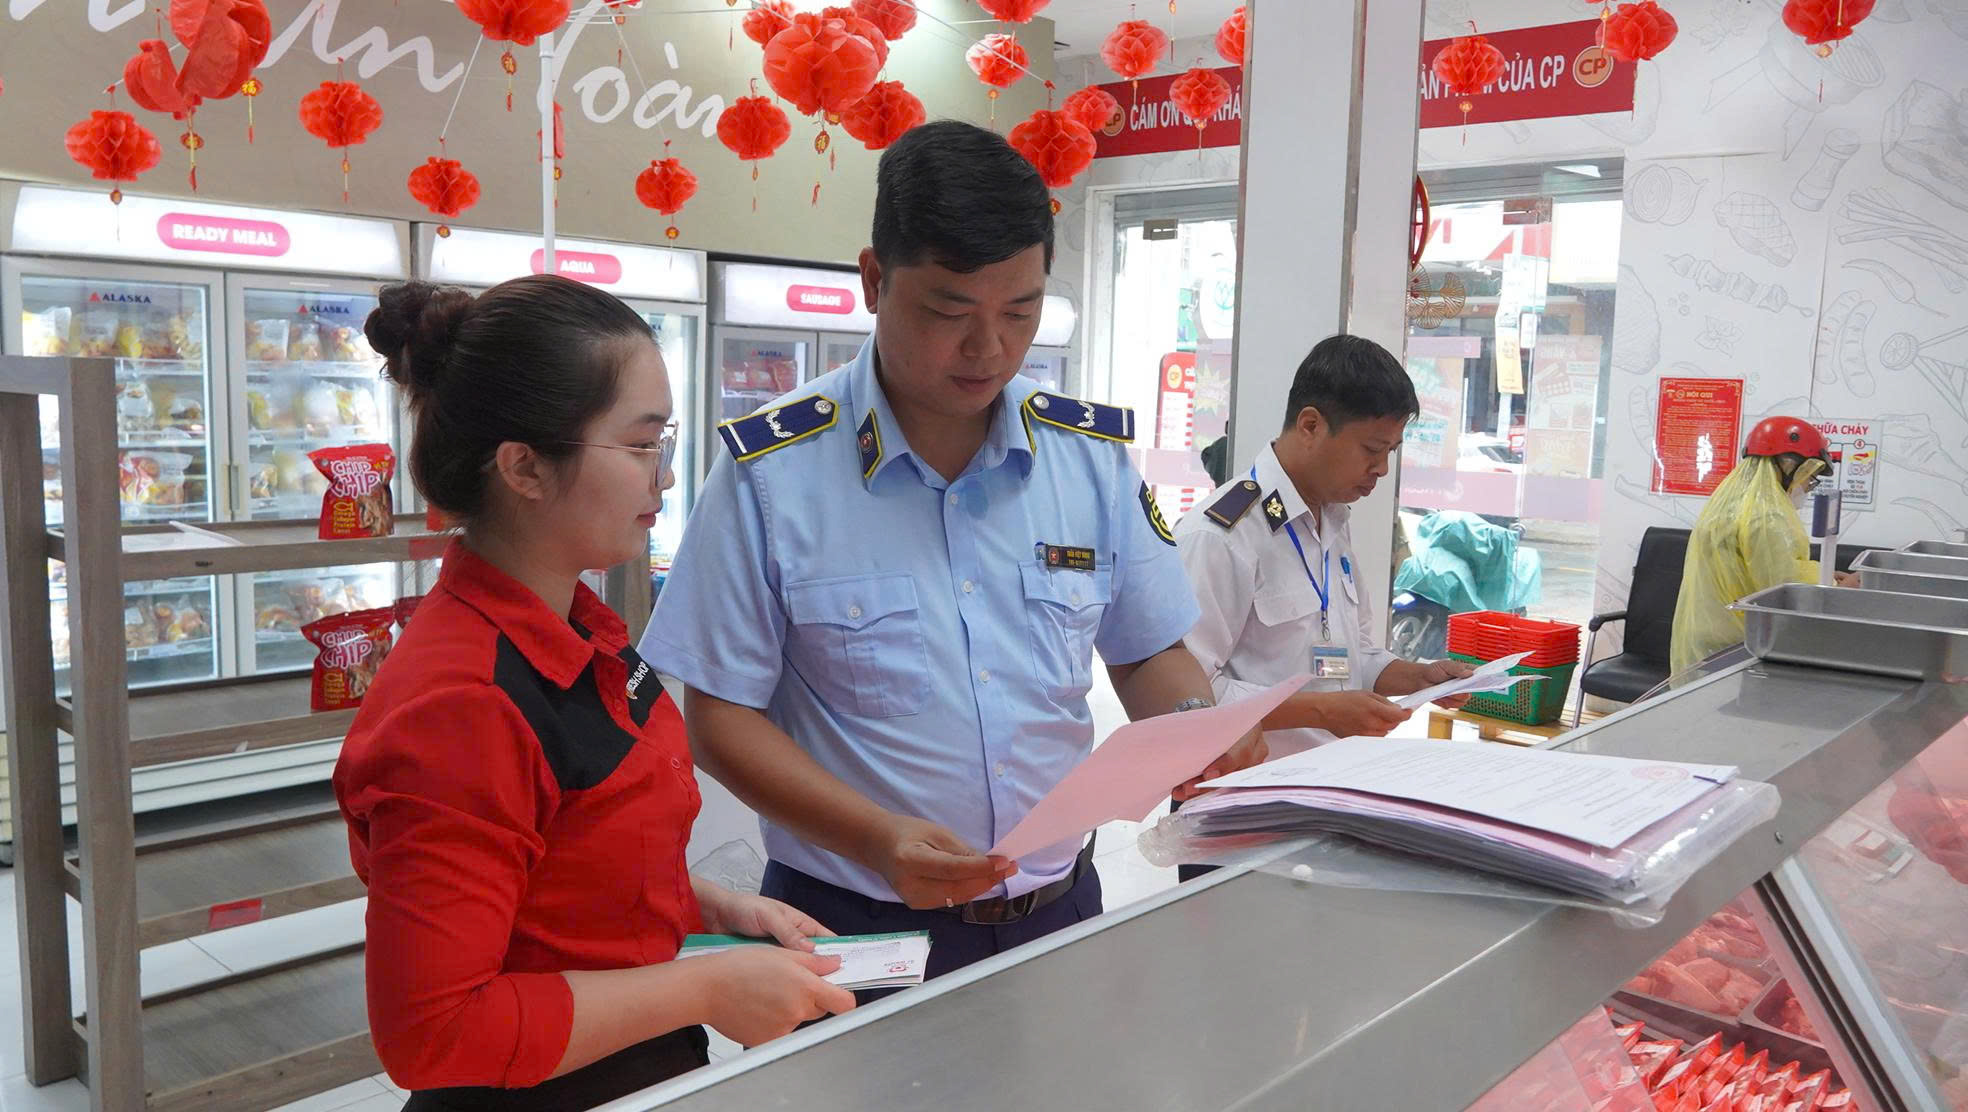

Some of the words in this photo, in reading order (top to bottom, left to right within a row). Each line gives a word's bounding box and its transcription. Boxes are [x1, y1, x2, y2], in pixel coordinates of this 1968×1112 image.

[1498, 52, 1535, 93] CỦA
[1541, 55, 1565, 88] CP
[1579, 58, 1607, 76] CP
[1130, 97, 1158, 131] CÁM
[172, 223, 227, 242] READY
[233, 229, 278, 248] MEAL
[560, 259, 596, 275] AQUA
[102, 293, 152, 304] ALASKA
[310, 304, 350, 315] ALASKA
[1814, 422, 1838, 435] HỮA
[330, 460, 372, 476] CHIP
[330, 470, 380, 500] CHIP
[321, 629, 367, 648] CHIP
[320, 639, 373, 670] CHIP
[633, 661, 649, 681] SHOP
